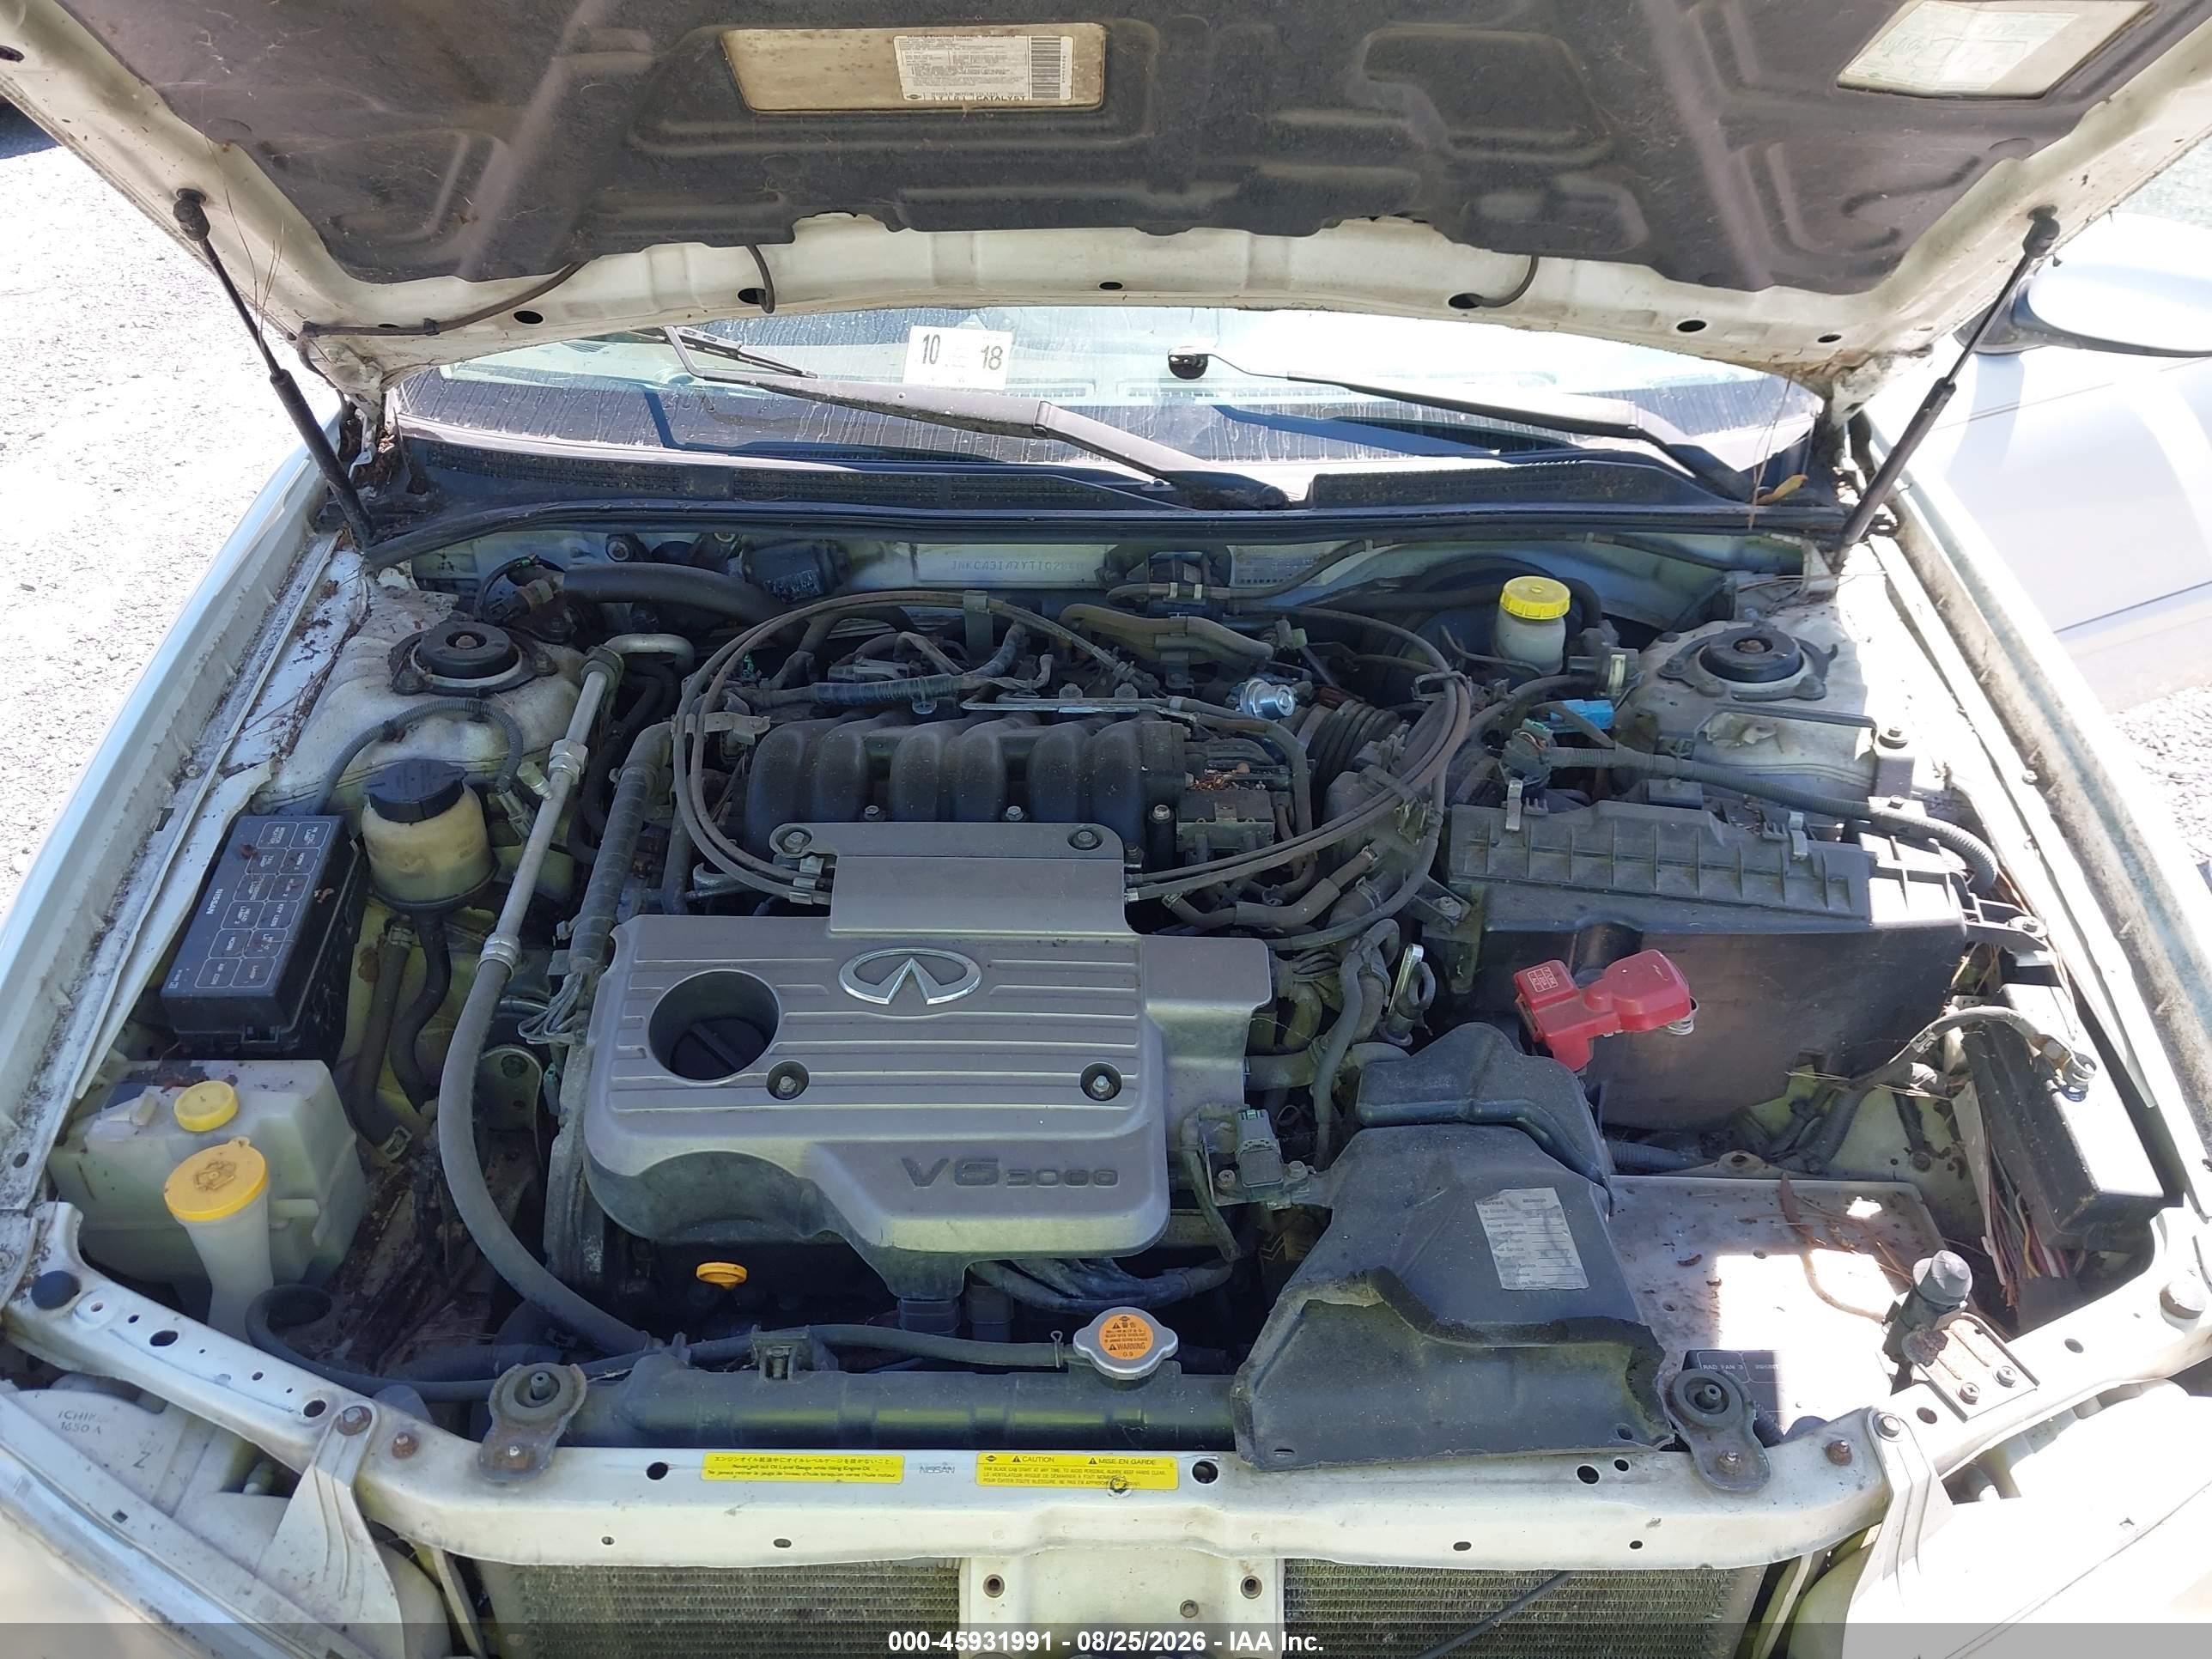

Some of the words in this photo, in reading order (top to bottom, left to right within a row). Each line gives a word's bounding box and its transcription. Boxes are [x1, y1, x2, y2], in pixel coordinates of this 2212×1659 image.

[922, 334, 941, 365] 10
[981, 345, 1003, 370] 18
[207, 889, 223, 914] NISSAN
[902, 1158, 999, 1187] V6
